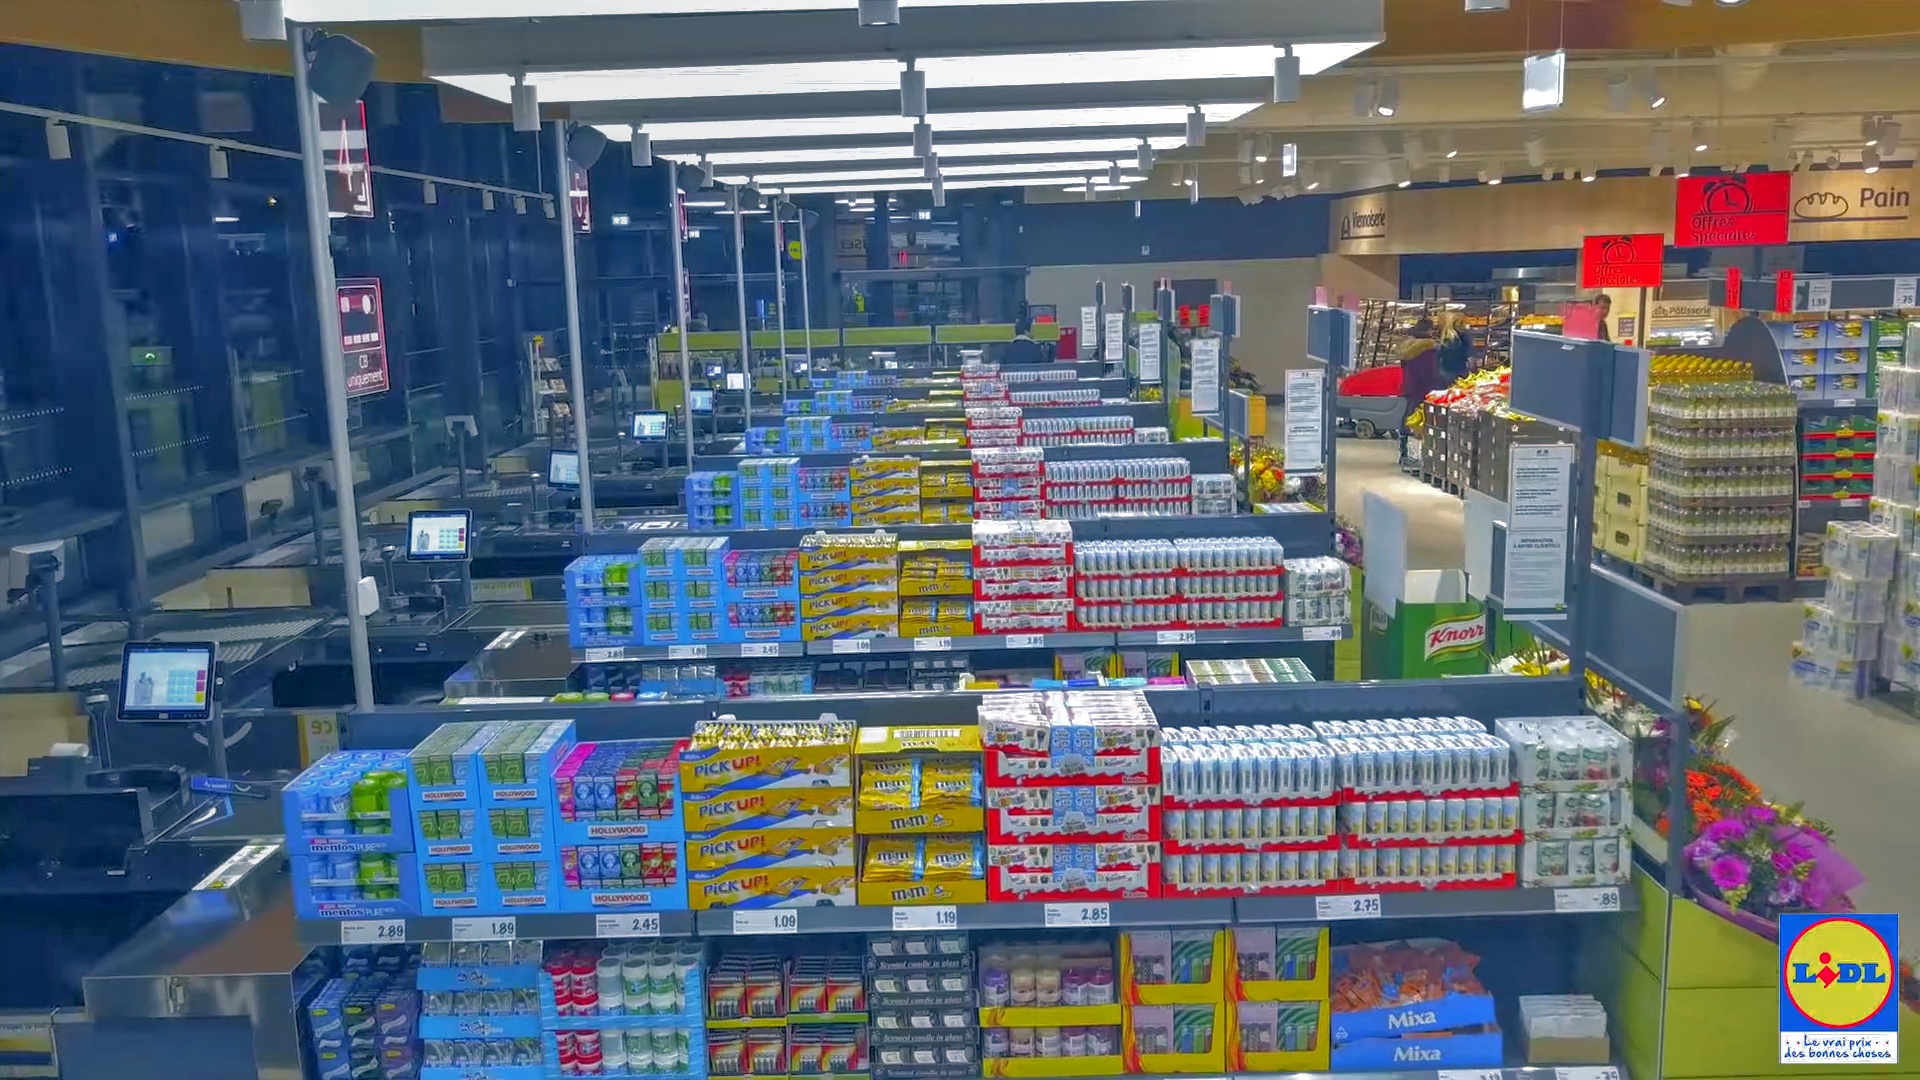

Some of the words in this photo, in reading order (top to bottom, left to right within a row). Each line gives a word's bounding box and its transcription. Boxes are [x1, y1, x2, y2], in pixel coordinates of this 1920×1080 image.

[1860, 187, 1910, 208] Pain
[347, 368, 383, 387] uniquement
[1430, 624, 1484, 648] Knorr
[732, 755, 760, 771] UP!
[424, 791, 464, 799] HOLLYWOOD
[496, 790, 535, 798] HOLLYWOOD
[737, 796, 764, 811] UP!
[590, 826, 646, 834] HOLLYWOOD
[311, 843, 356, 852] mentos
[737, 836, 765, 850] UP!
[741, 875, 769, 890] UP!
[505, 897, 544, 905] HOLLYWOOD
[595, 894, 648, 903] HOLLYWOOD
[1353, 899, 1379, 911] 2.75
[320, 908, 365, 917] mentos
[936, 911, 956, 924] 1.19
[1081, 908, 1108, 920] 2.85
[632, 918, 658, 931] 2.45
[774, 915, 796, 928] 1.09
[377, 925, 404, 938] 2.89
[492, 922, 514, 936] 1.89
[1388, 1010, 1437, 1029] Mixa
[1393, 1045, 1442, 1062] Mixa
